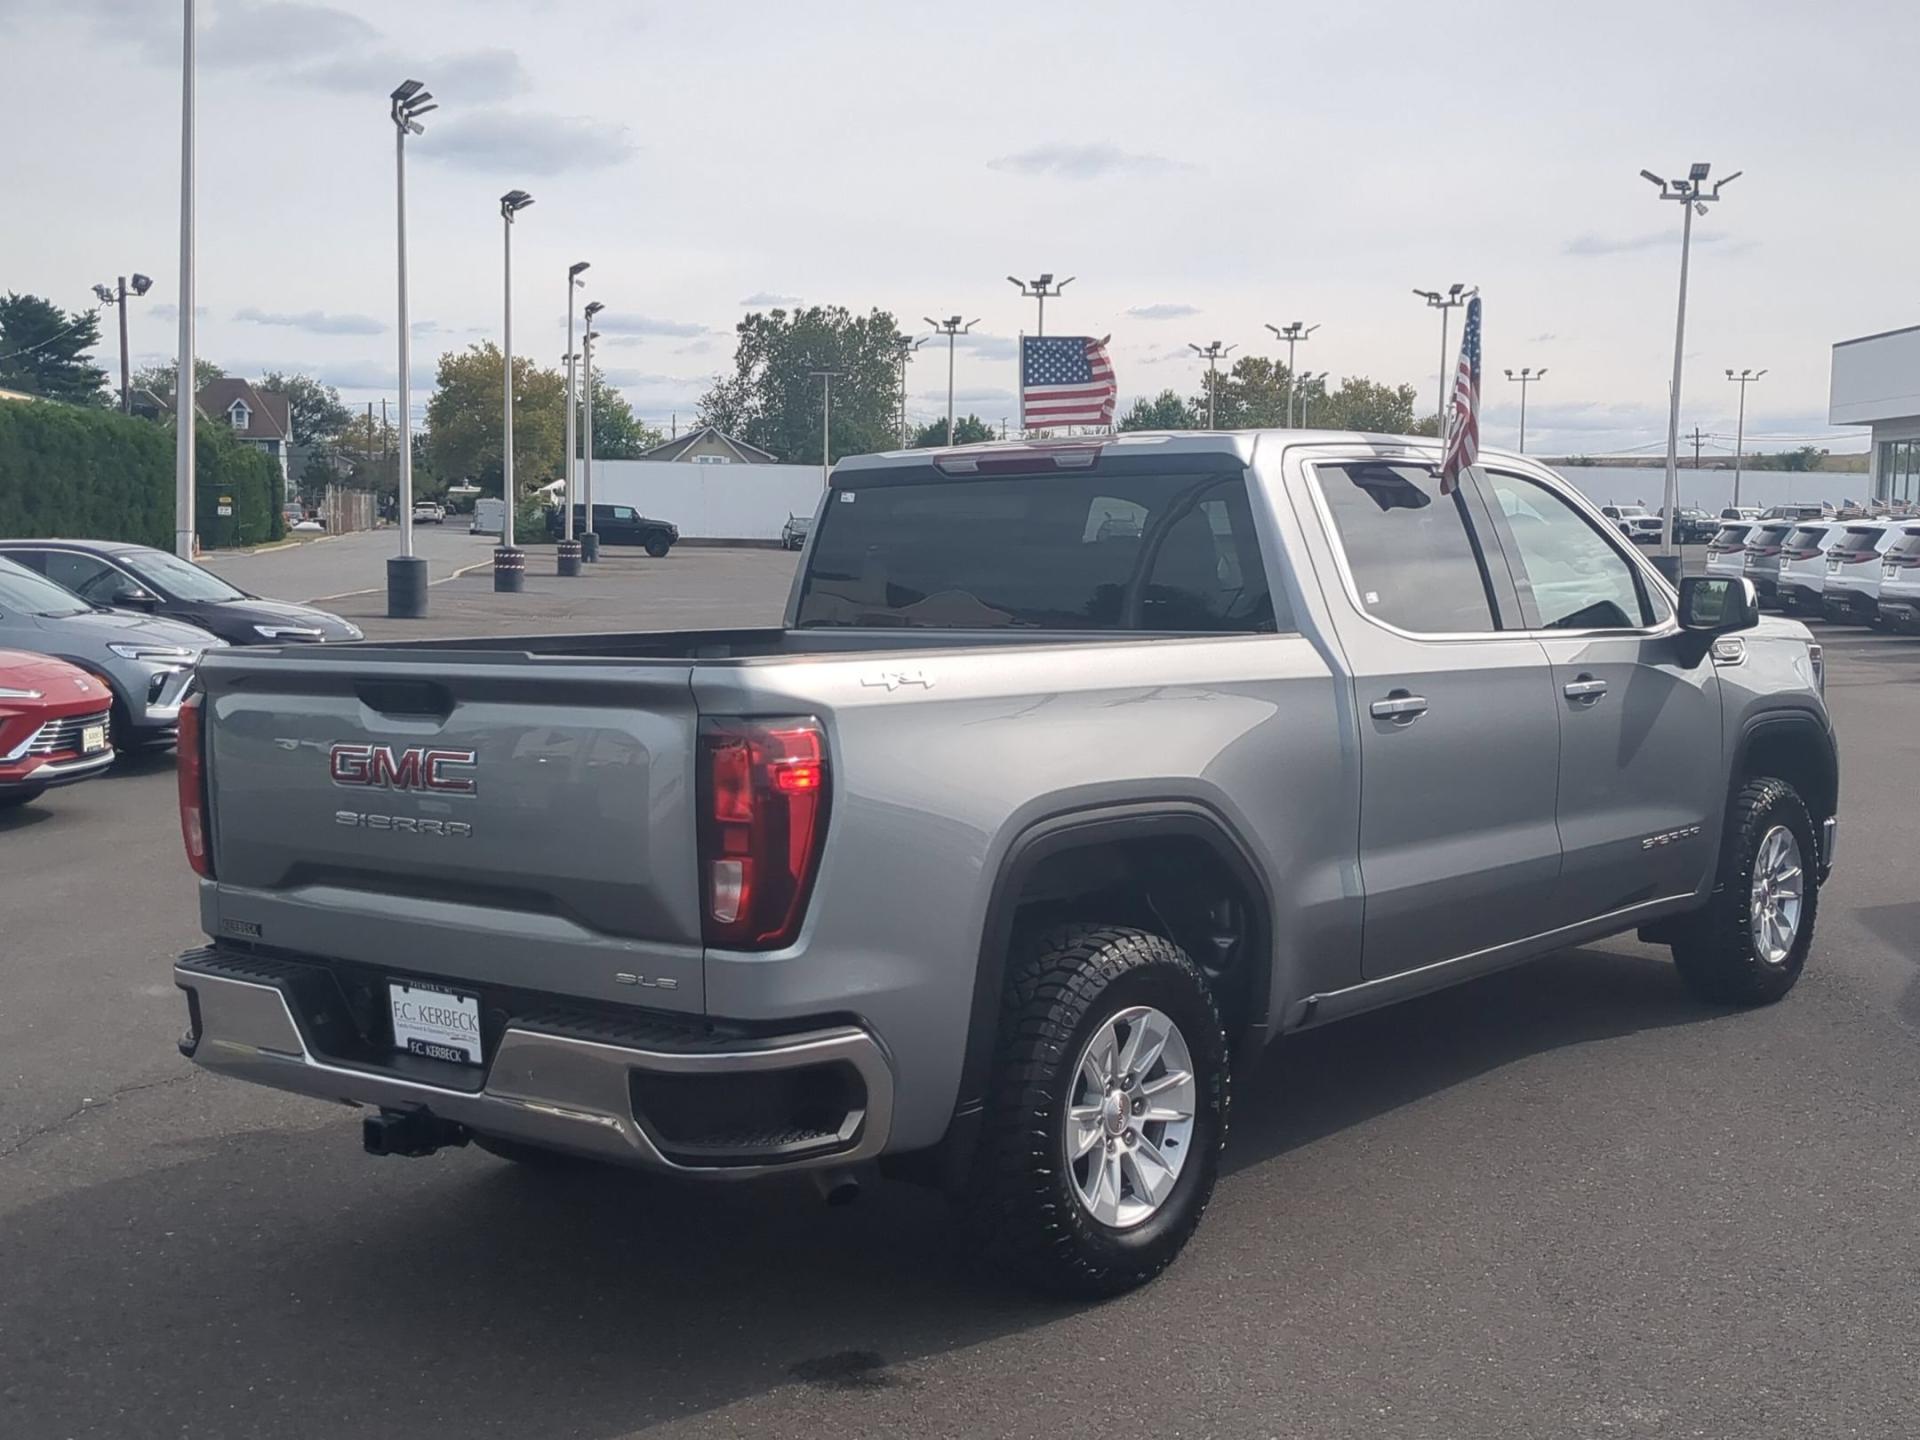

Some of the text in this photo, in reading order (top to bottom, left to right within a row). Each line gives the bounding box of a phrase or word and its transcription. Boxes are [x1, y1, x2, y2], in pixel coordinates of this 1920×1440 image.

[329, 743, 477, 794] GMC
[335, 810, 473, 838] SIERRA
[615, 972, 678, 989] SLE
[393, 1000, 416, 1021] F.C.
[418, 1005, 479, 1032] KERBECK
[410, 1041, 462, 1062] F.C. KERBECK
